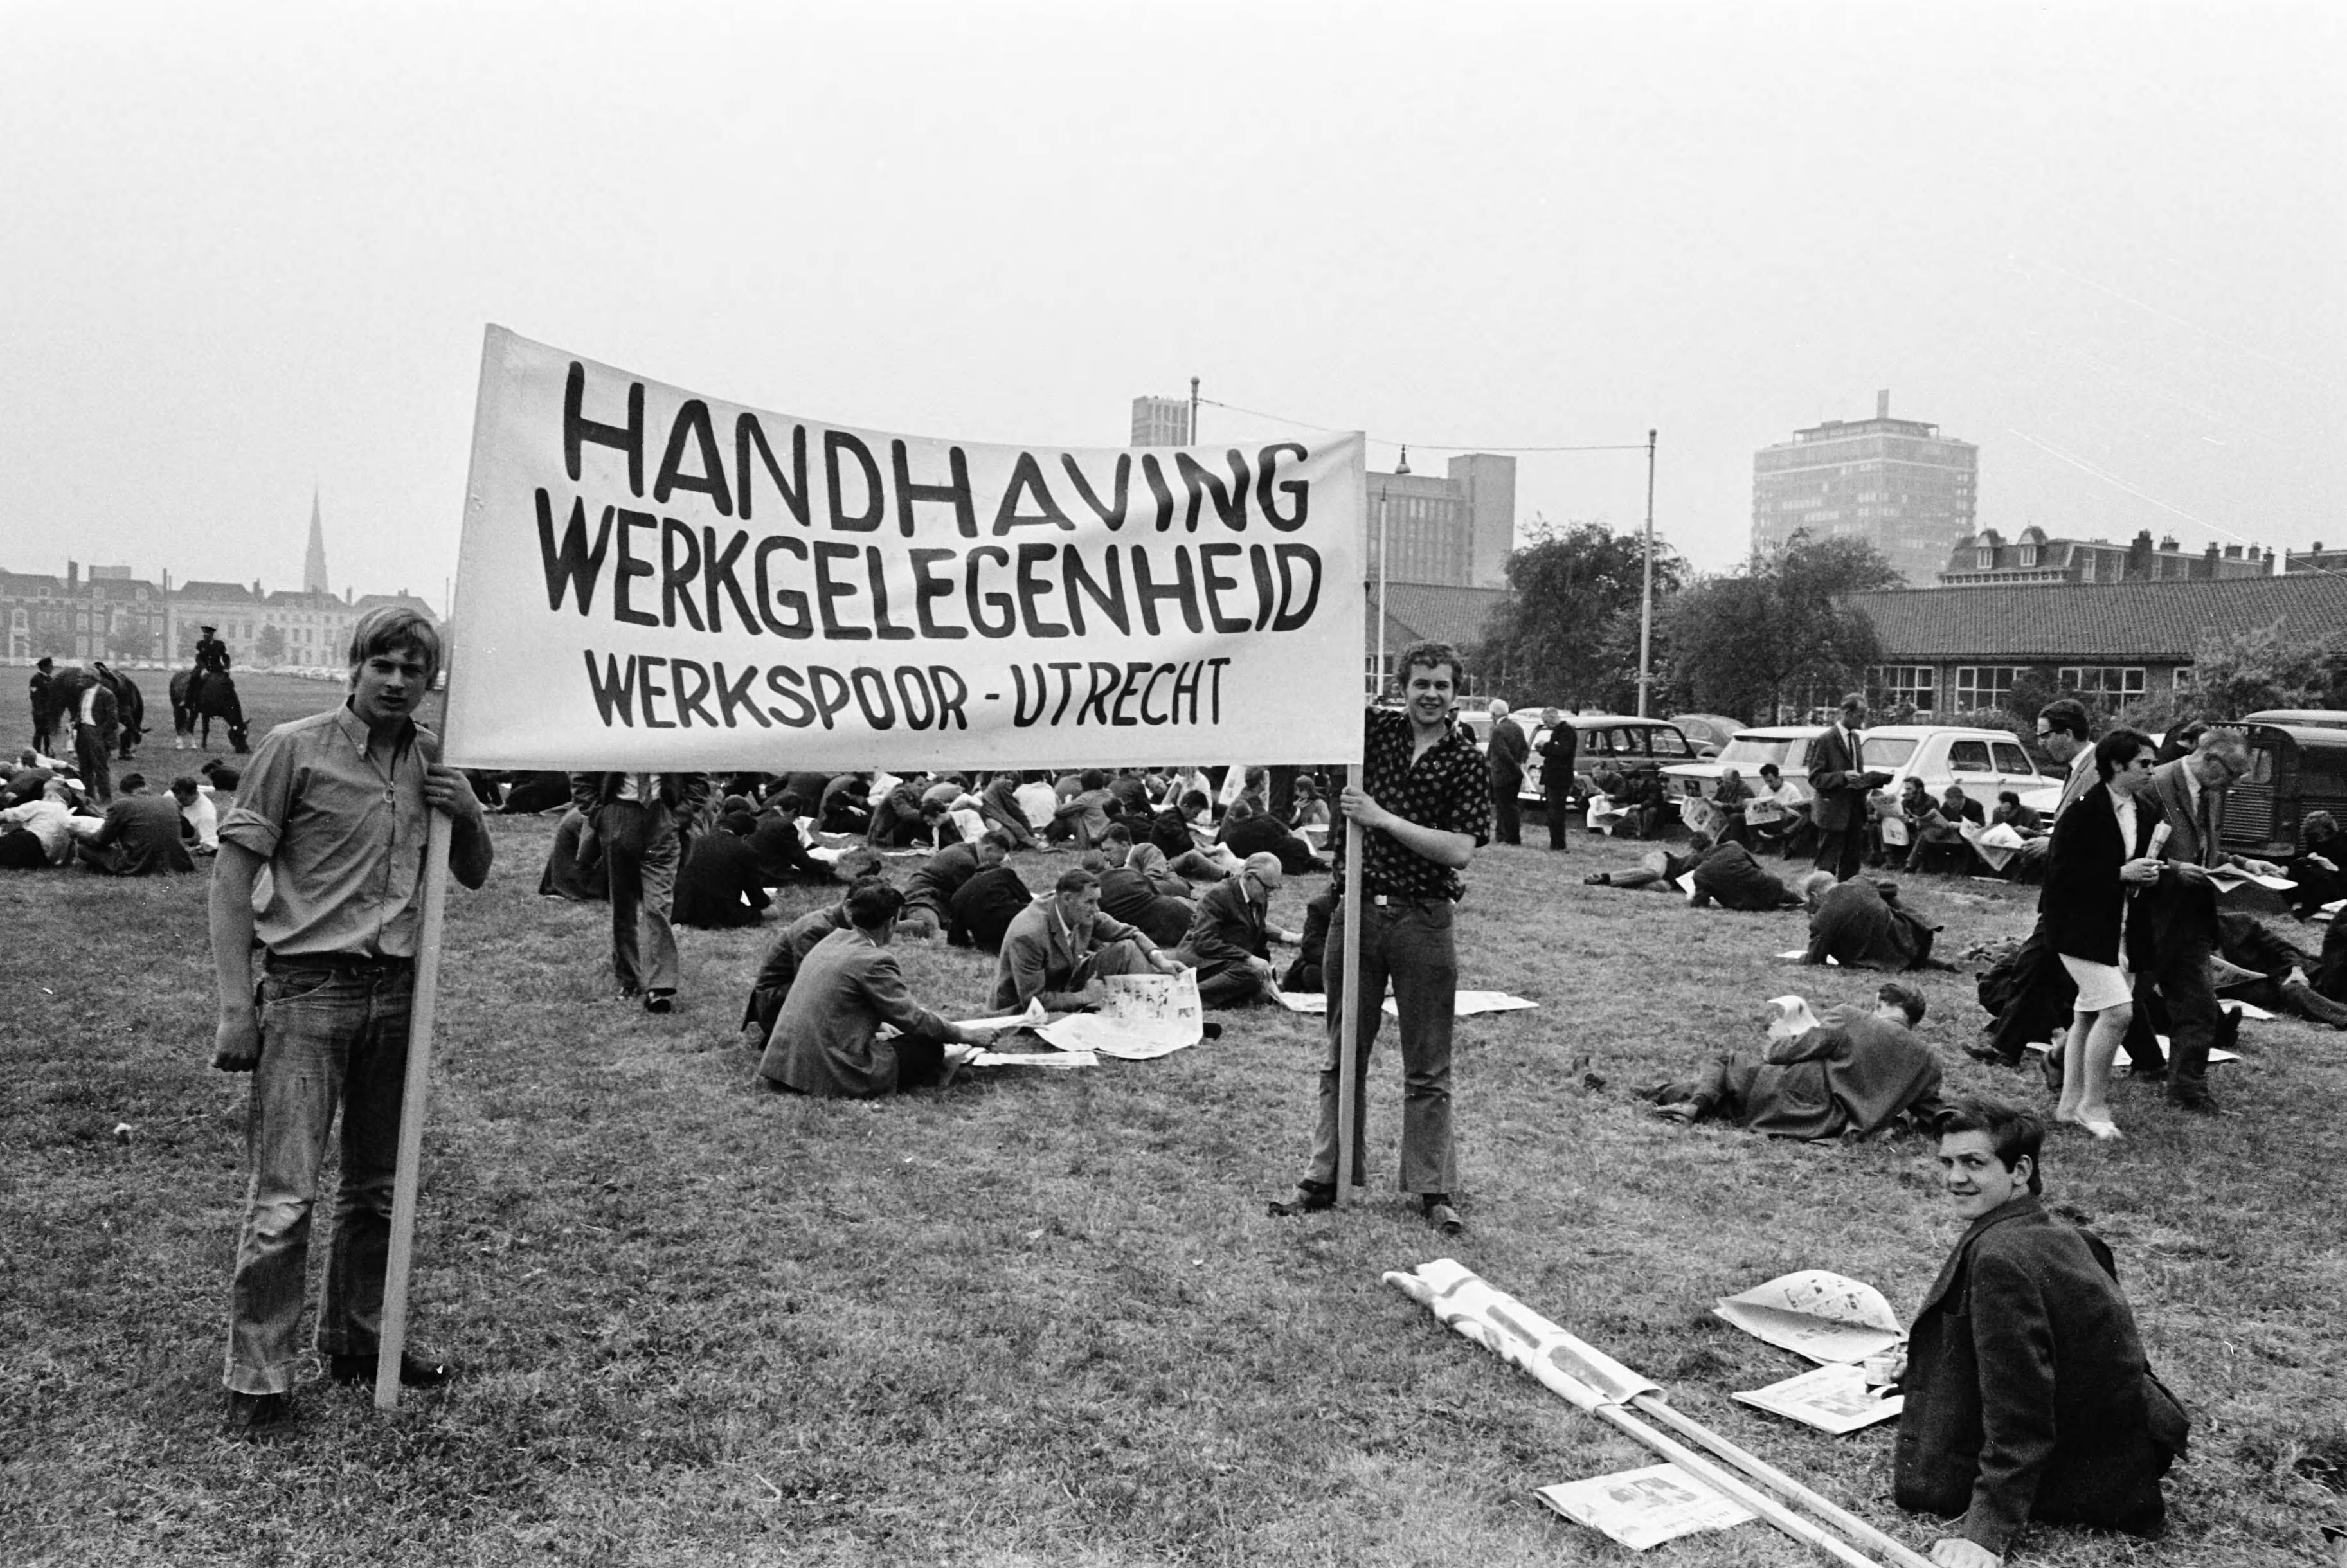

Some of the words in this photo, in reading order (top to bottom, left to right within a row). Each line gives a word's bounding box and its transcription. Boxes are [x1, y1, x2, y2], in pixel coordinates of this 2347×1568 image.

[564, 361, 1309, 537] HANDHAVING
[535, 488, 1322, 640] WERKGELEGENHEID
[584, 649, 967, 730] WERKSPOOR
[1011, 658, 1230, 727] UTRECHT
